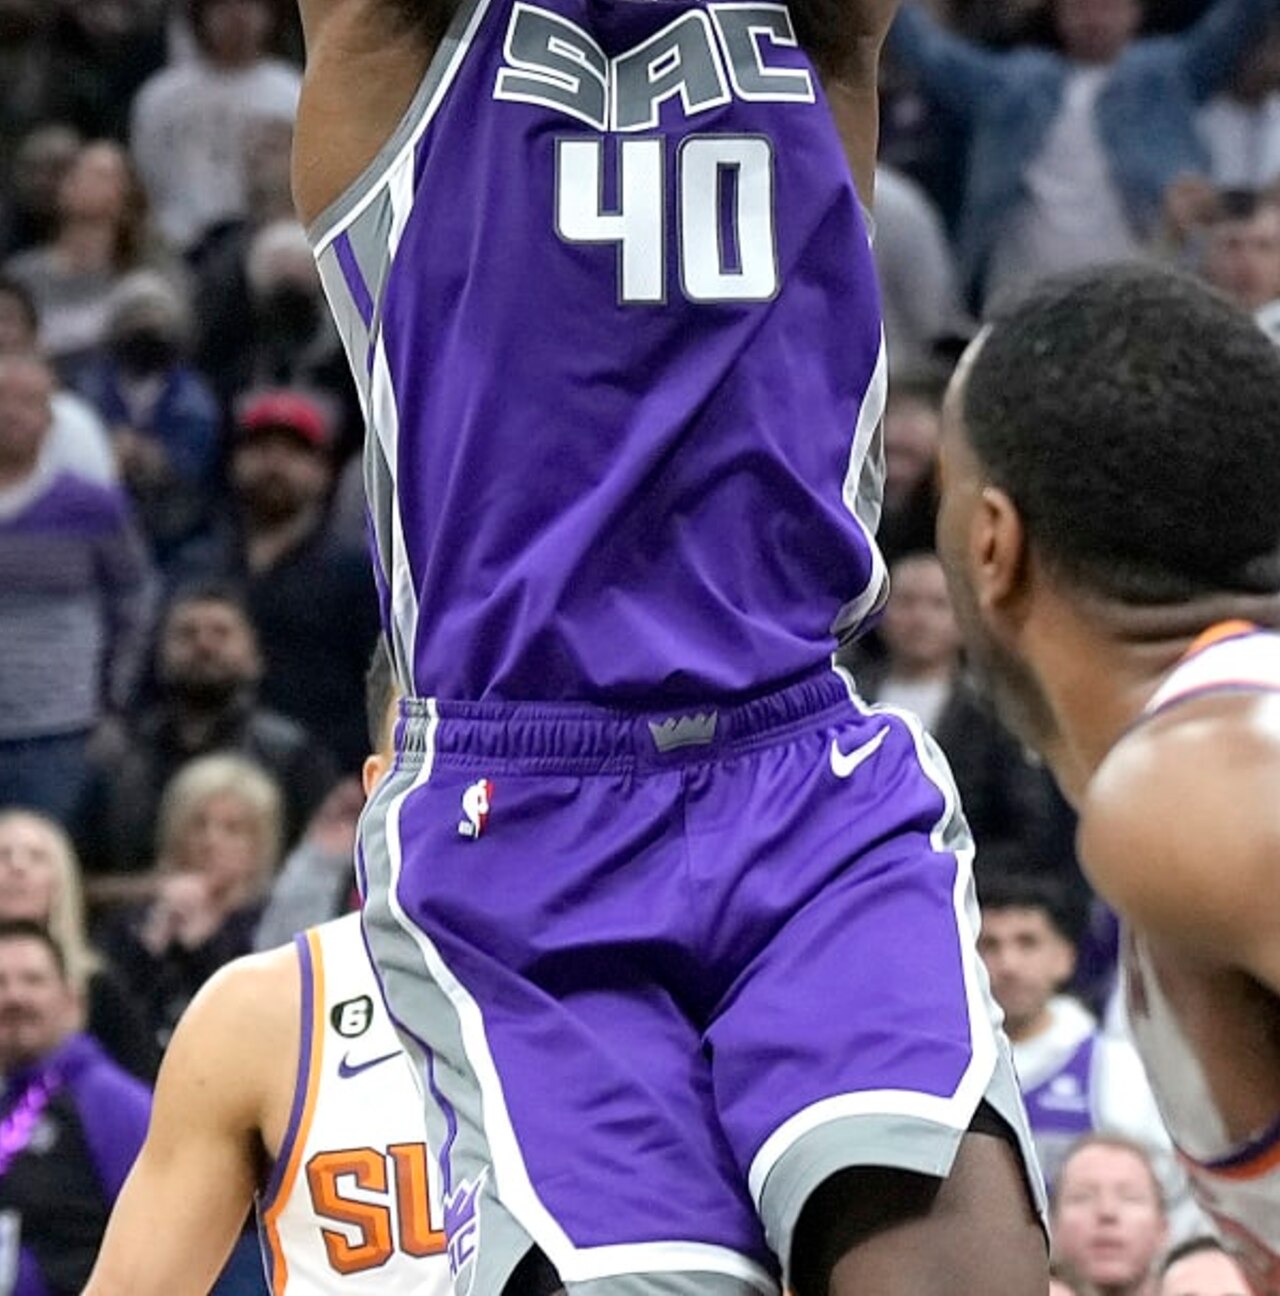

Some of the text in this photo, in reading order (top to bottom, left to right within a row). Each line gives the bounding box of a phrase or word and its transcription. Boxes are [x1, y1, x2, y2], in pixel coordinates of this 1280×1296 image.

[493, 0, 815, 132] SAC
[553, 133, 781, 305] 40
[340, 998, 368, 1035] 6
